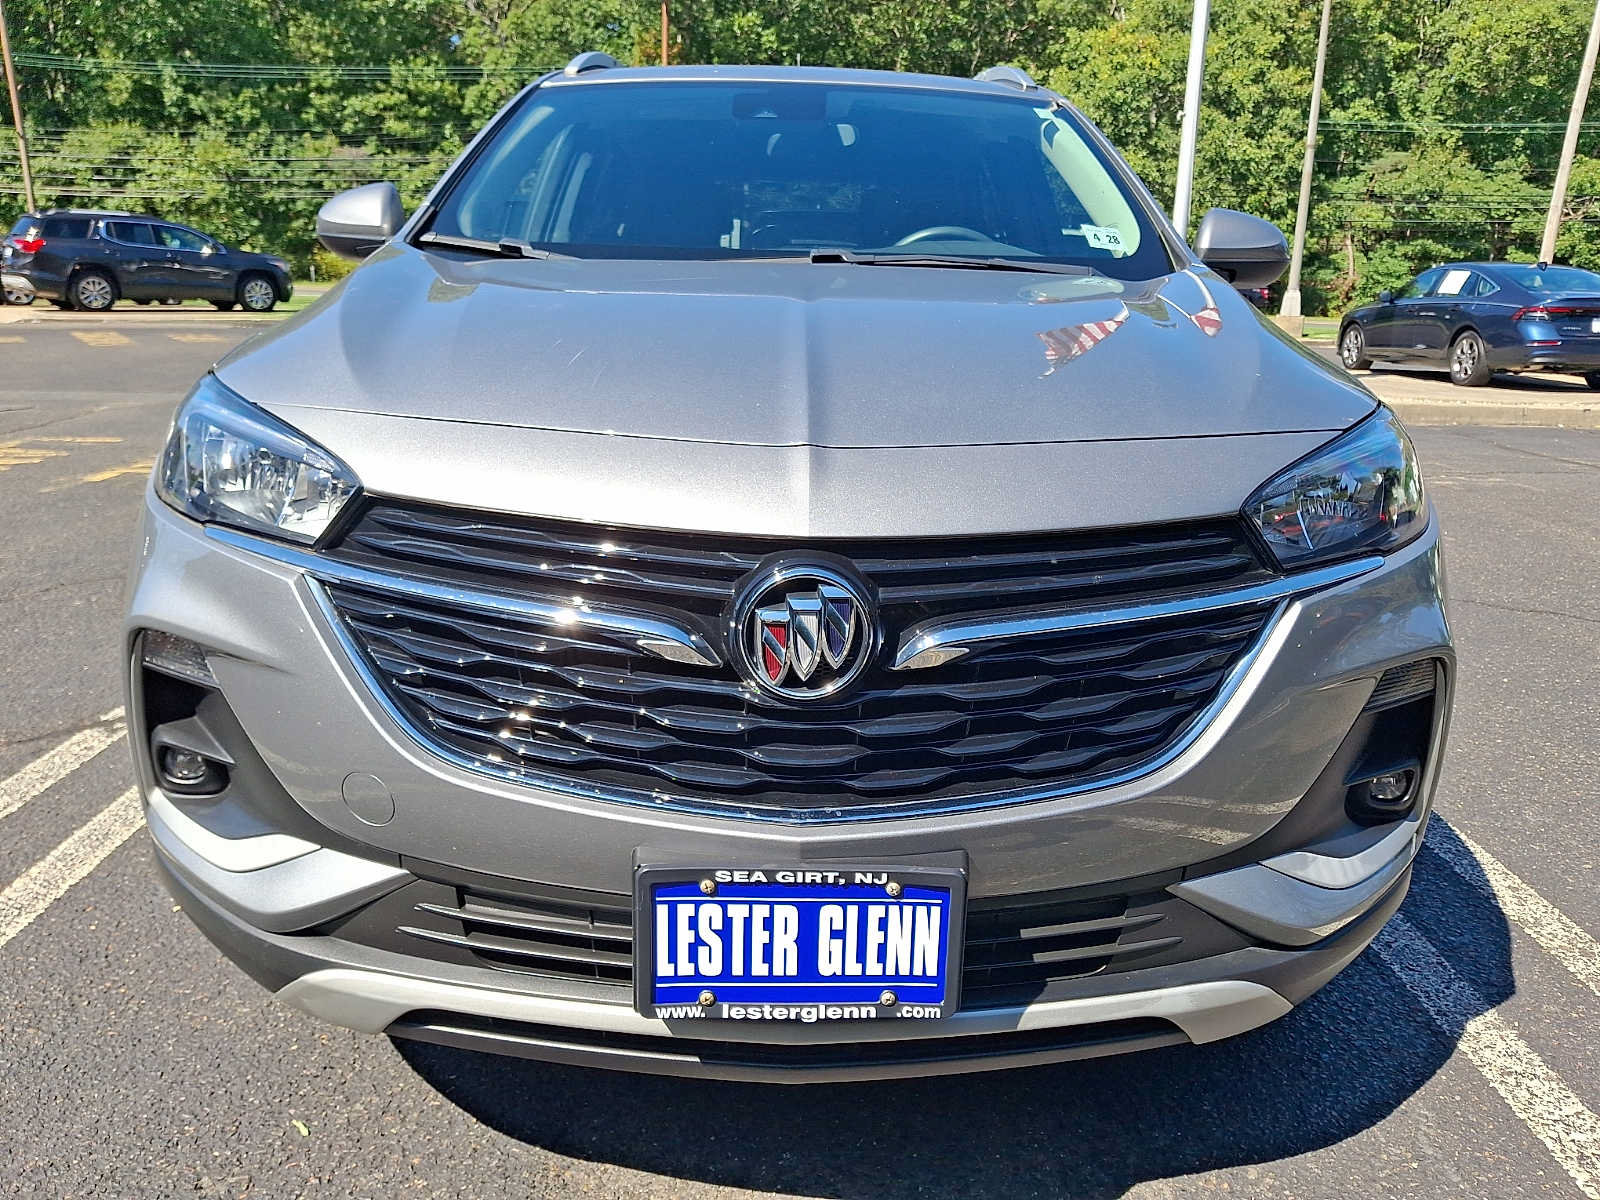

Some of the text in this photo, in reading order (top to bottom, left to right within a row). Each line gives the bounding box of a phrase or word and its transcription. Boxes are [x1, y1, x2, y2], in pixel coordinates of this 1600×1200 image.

[1106, 234, 1120, 244] 28
[715, 870, 888, 885] SEA GIRT, NJ
[656, 903, 941, 977] LESTER GLENN
